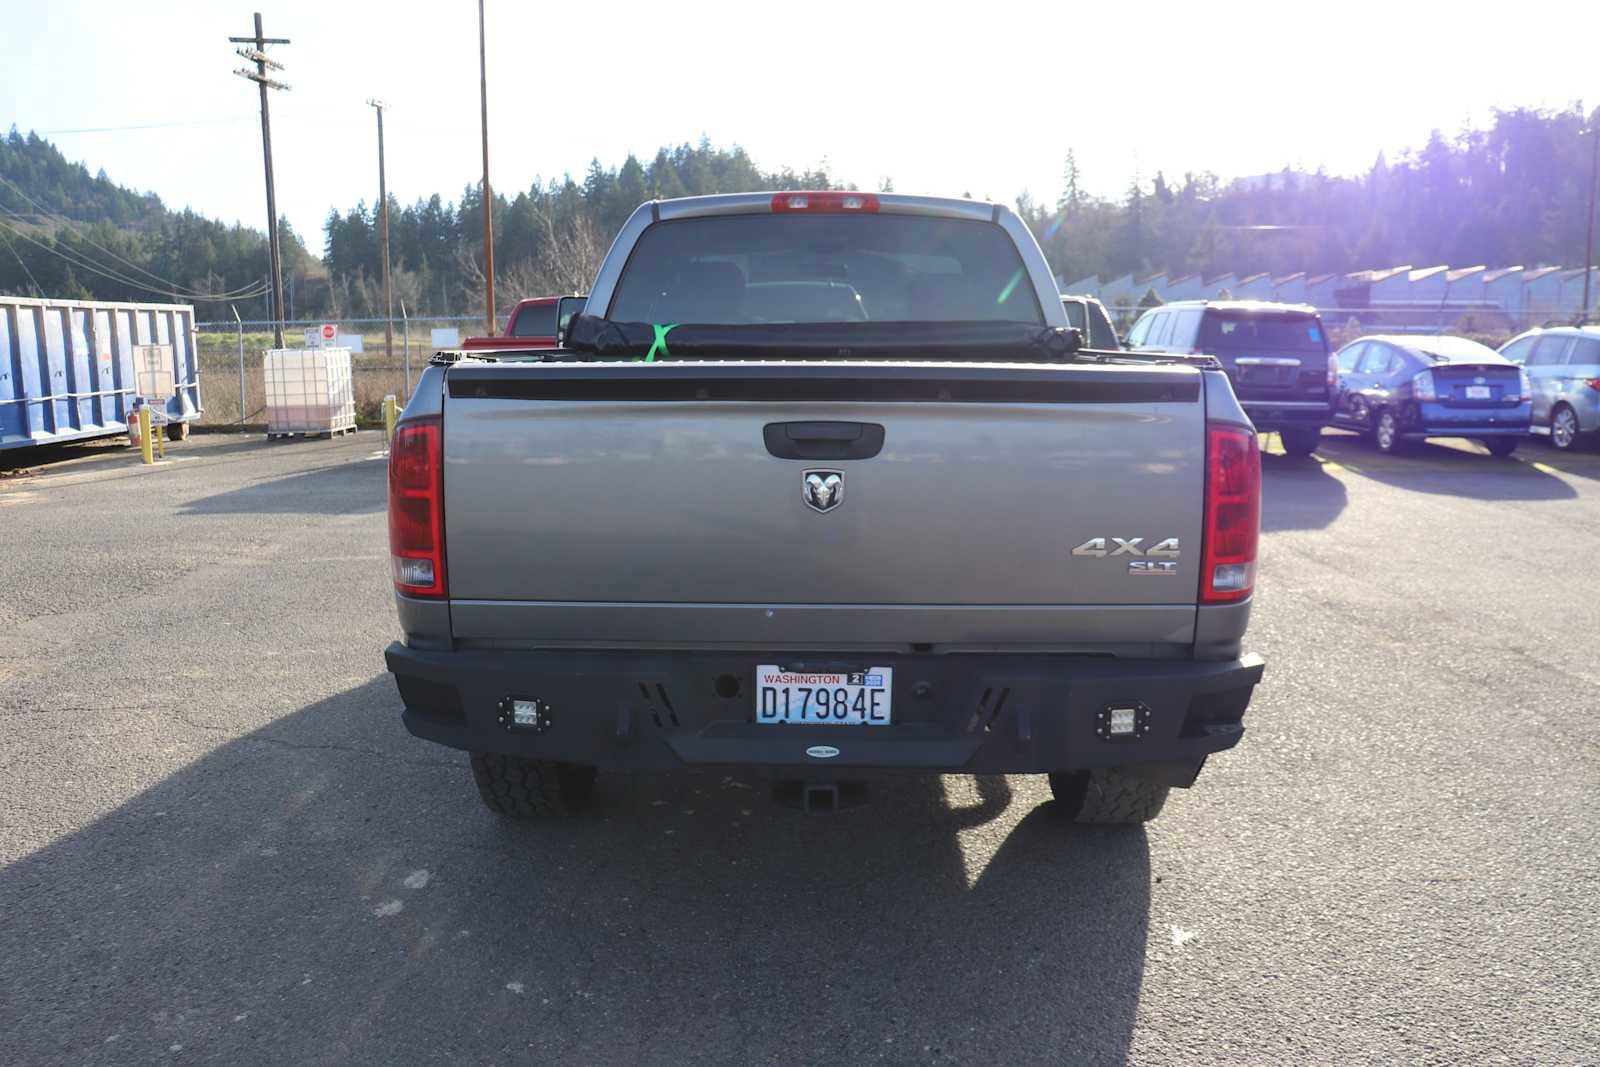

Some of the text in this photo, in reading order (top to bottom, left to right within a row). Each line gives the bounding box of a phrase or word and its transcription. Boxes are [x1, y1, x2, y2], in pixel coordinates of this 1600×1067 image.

[1128, 561, 1177, 571] SLT
[763, 674, 840, 684] WASHINGTON
[762, 687, 885, 720] D17984E
